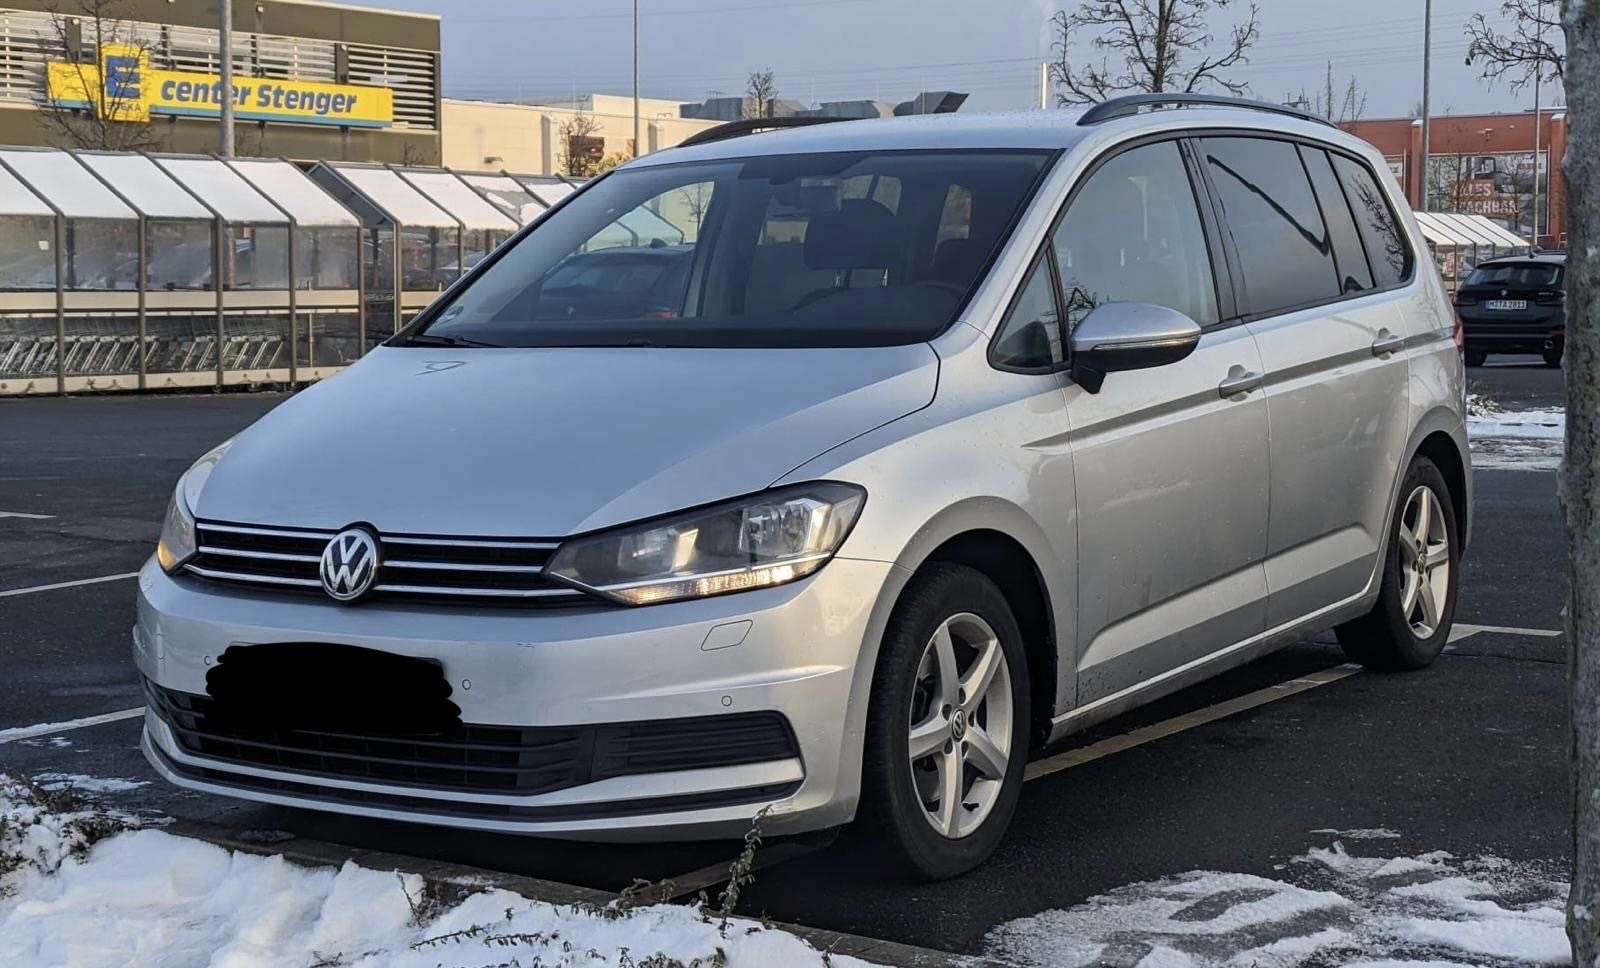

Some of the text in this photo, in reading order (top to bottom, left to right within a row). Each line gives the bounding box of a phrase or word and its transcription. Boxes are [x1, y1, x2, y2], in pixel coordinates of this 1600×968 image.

[106, 56, 140, 98] E
[256, 84, 357, 115] Stenger
[321, 529, 377, 600] VW
